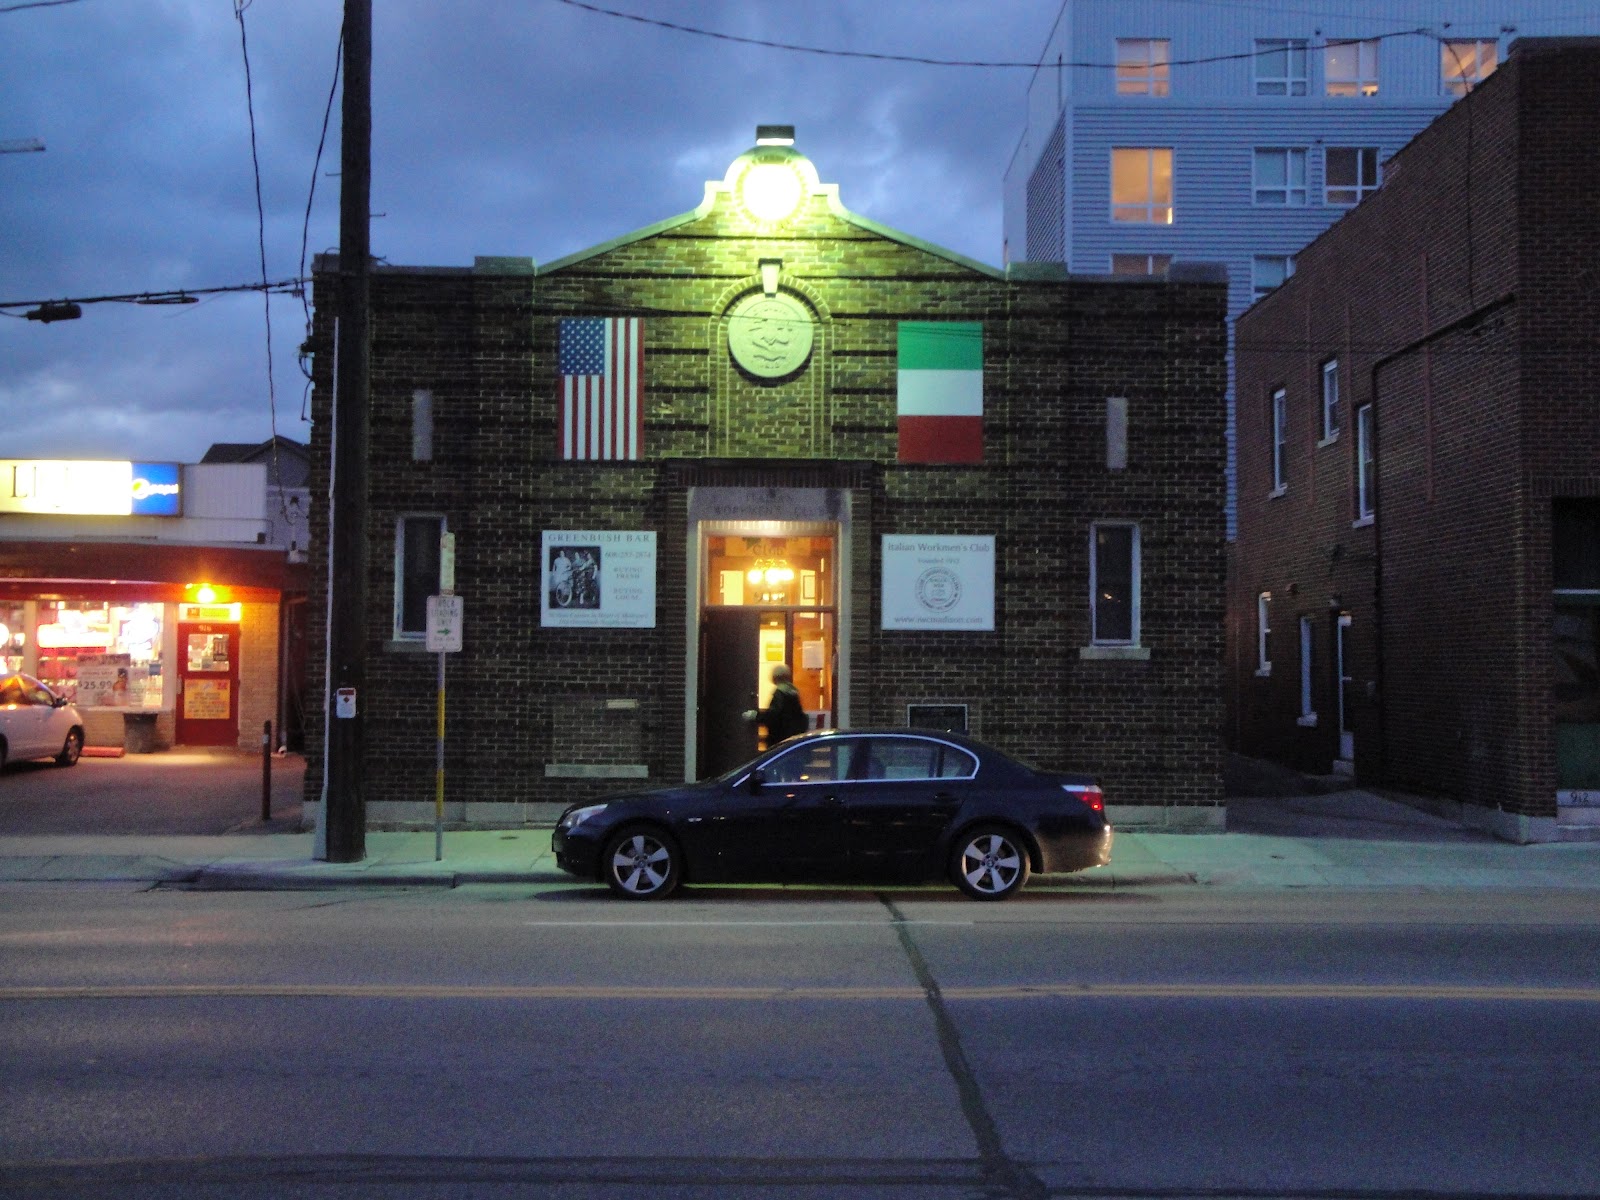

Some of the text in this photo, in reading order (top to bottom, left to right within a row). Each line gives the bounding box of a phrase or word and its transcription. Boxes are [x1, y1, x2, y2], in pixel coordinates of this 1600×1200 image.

[548, 534, 650, 542] GREENBUSH BAR
[752, 544, 785, 556] Club
[888, 543, 990, 552] Italian Workmen's Club
